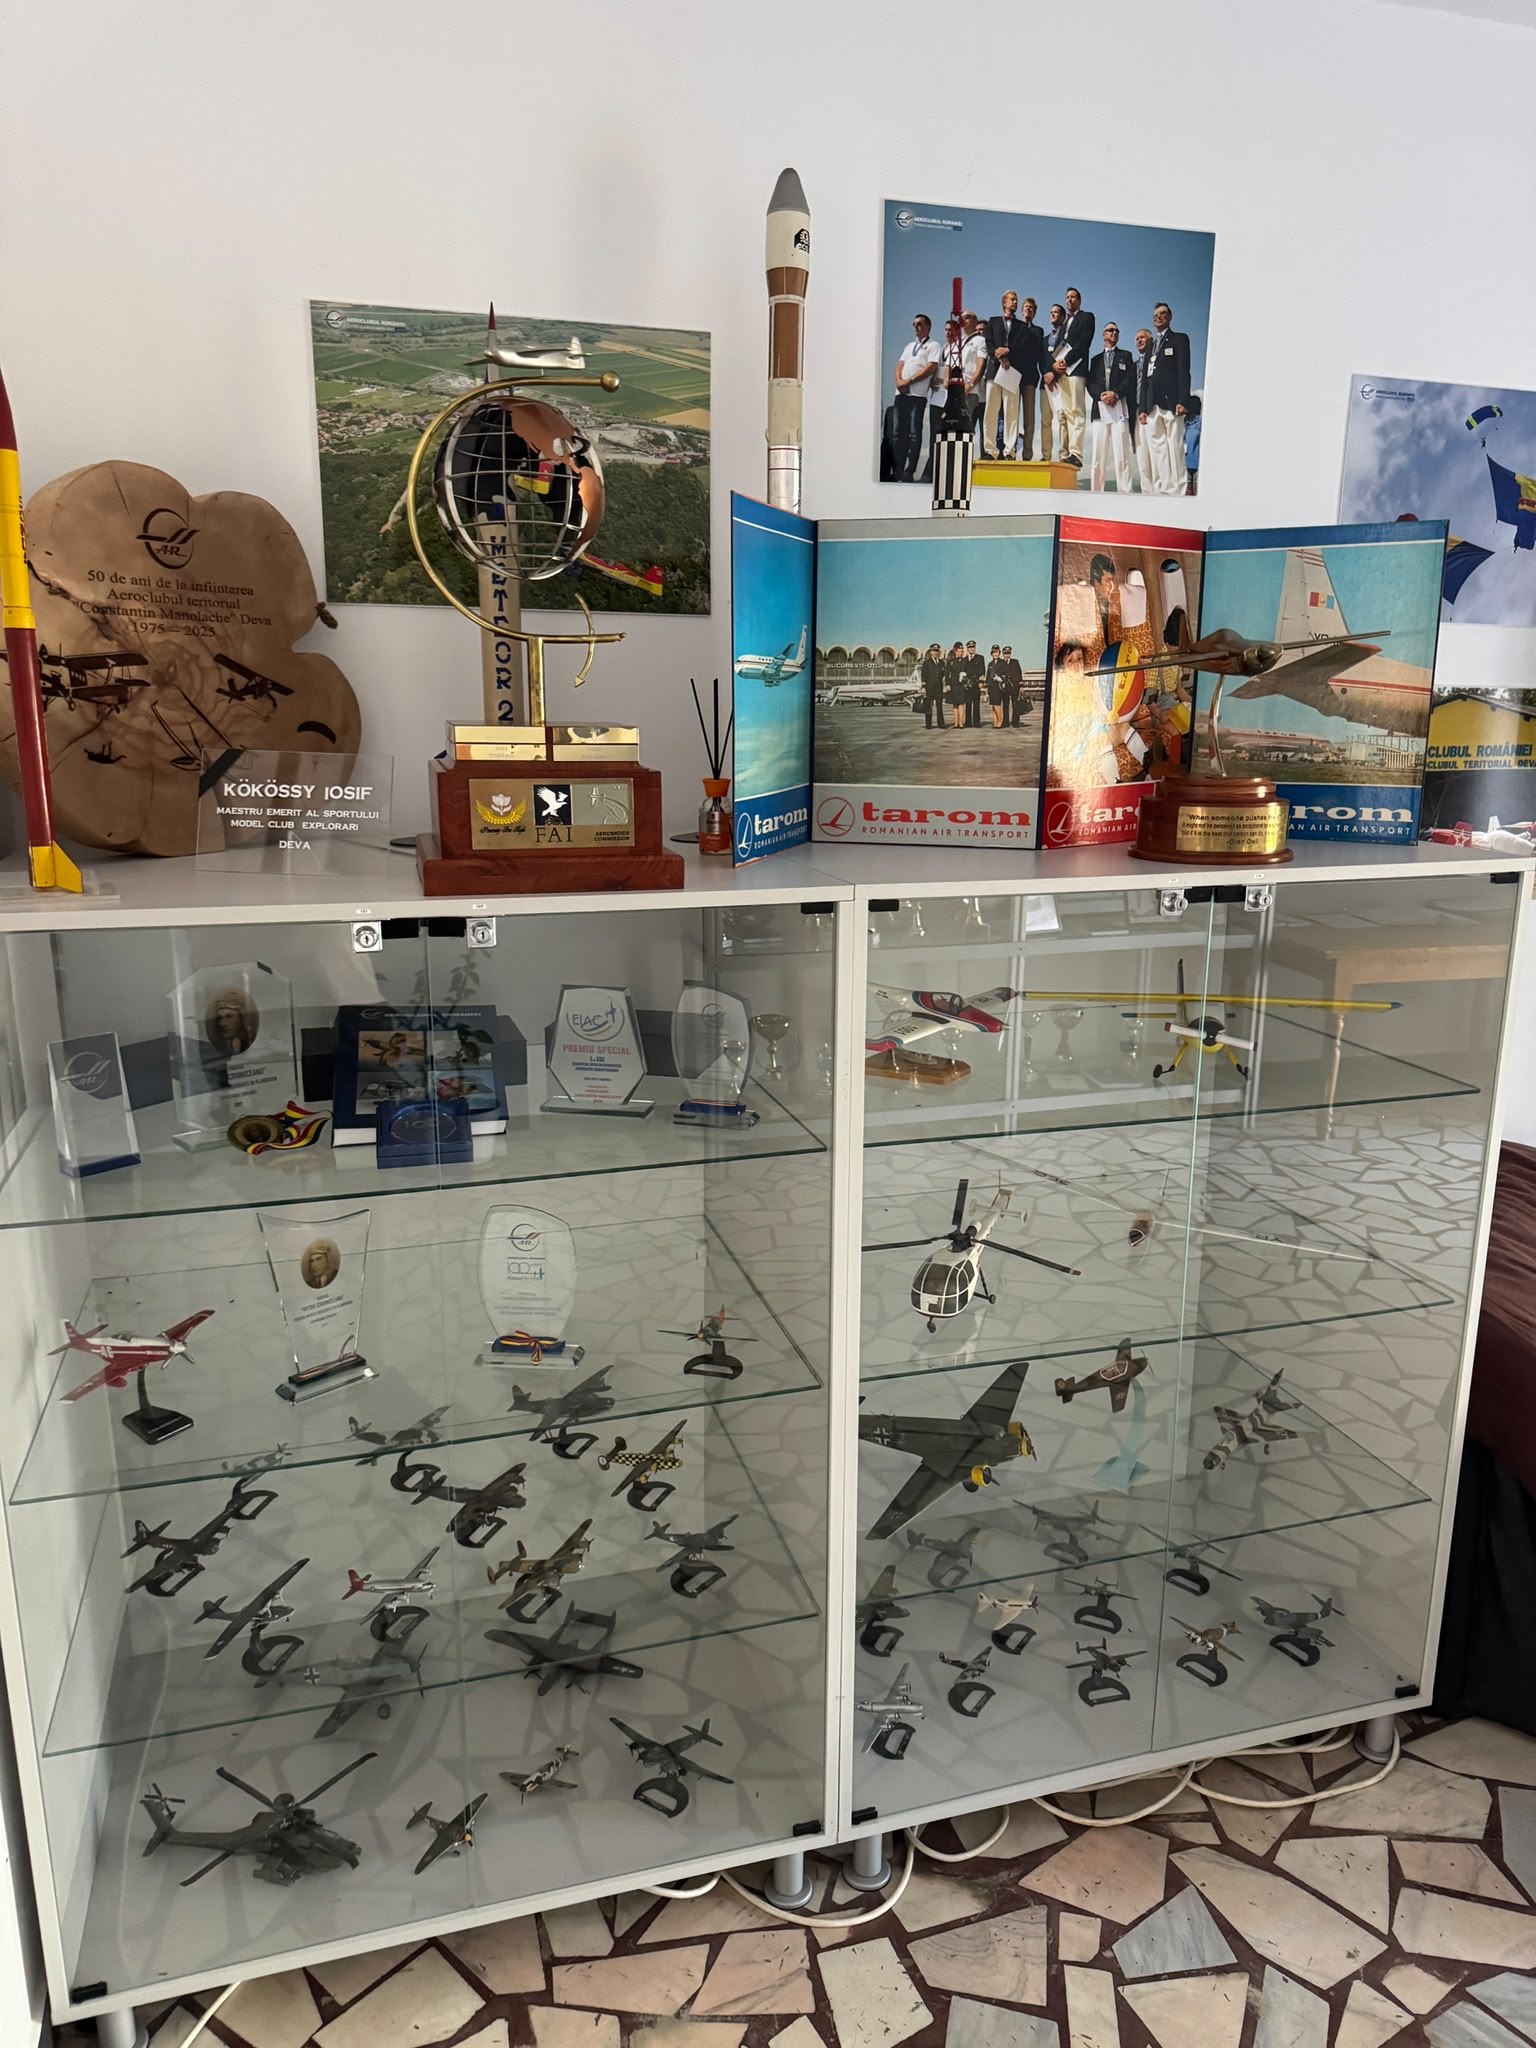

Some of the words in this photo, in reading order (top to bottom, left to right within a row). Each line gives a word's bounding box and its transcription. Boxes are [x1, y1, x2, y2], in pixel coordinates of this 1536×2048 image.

[88, 570, 105, 582] 50
[110, 572, 126, 584] de
[131, 576, 151, 587] ani
[156, 576, 171, 589] de
[176, 579, 187, 590] la
[107, 588, 183, 606] Aeroclubul
[187, 597, 240, 610] teritorial
[240, 614, 272, 626] Deva
[132, 622, 165, 634] 1975
[184, 626, 216, 638] 2025
[1428, 745, 1472, 758] CLUBUL
[1476, 742, 1533, 758] ROMÂNIEI
[1464, 760, 1512, 768] TERITORIAL
[224, 778, 316, 798] KÖKÖSSY
[324, 786, 373, 800] IOSIF
[216, 806, 263, 816] MAESTRU
[266, 808, 302, 817] EMERIT
[306, 810, 320, 818] AL
[323, 810, 379, 819] SPORTULUI
[862, 802, 1032, 826] tarom
[1291, 805, 1414, 822] rom
[230, 820, 264, 828] MODEL
[268, 820, 294, 829] CLUB
[302, 822, 359, 831] EXPLORARI
[754, 806, 808, 836] tarom
[535, 827, 573, 843] FAI
[754, 834, 779, 850] ROMANIAN
[786, 824, 808, 840] TRANSPORT
[862, 826, 928, 836] ROMANIAN
[932, 828, 952, 836] AIR
[957, 830, 1030, 838] TRANSPORT
[1079, 825, 1122, 836] ROMANIAN
[1310, 824, 1330, 832] AIR
[1336, 824, 1410, 835] TRANSPORT
[279, 840, 311, 850] DEVA
[572, 1013, 604, 1028] EIAC
[563, 1044, 594, 1053] PREMIU
[596, 1046, 632, 1056] SPECIAL
